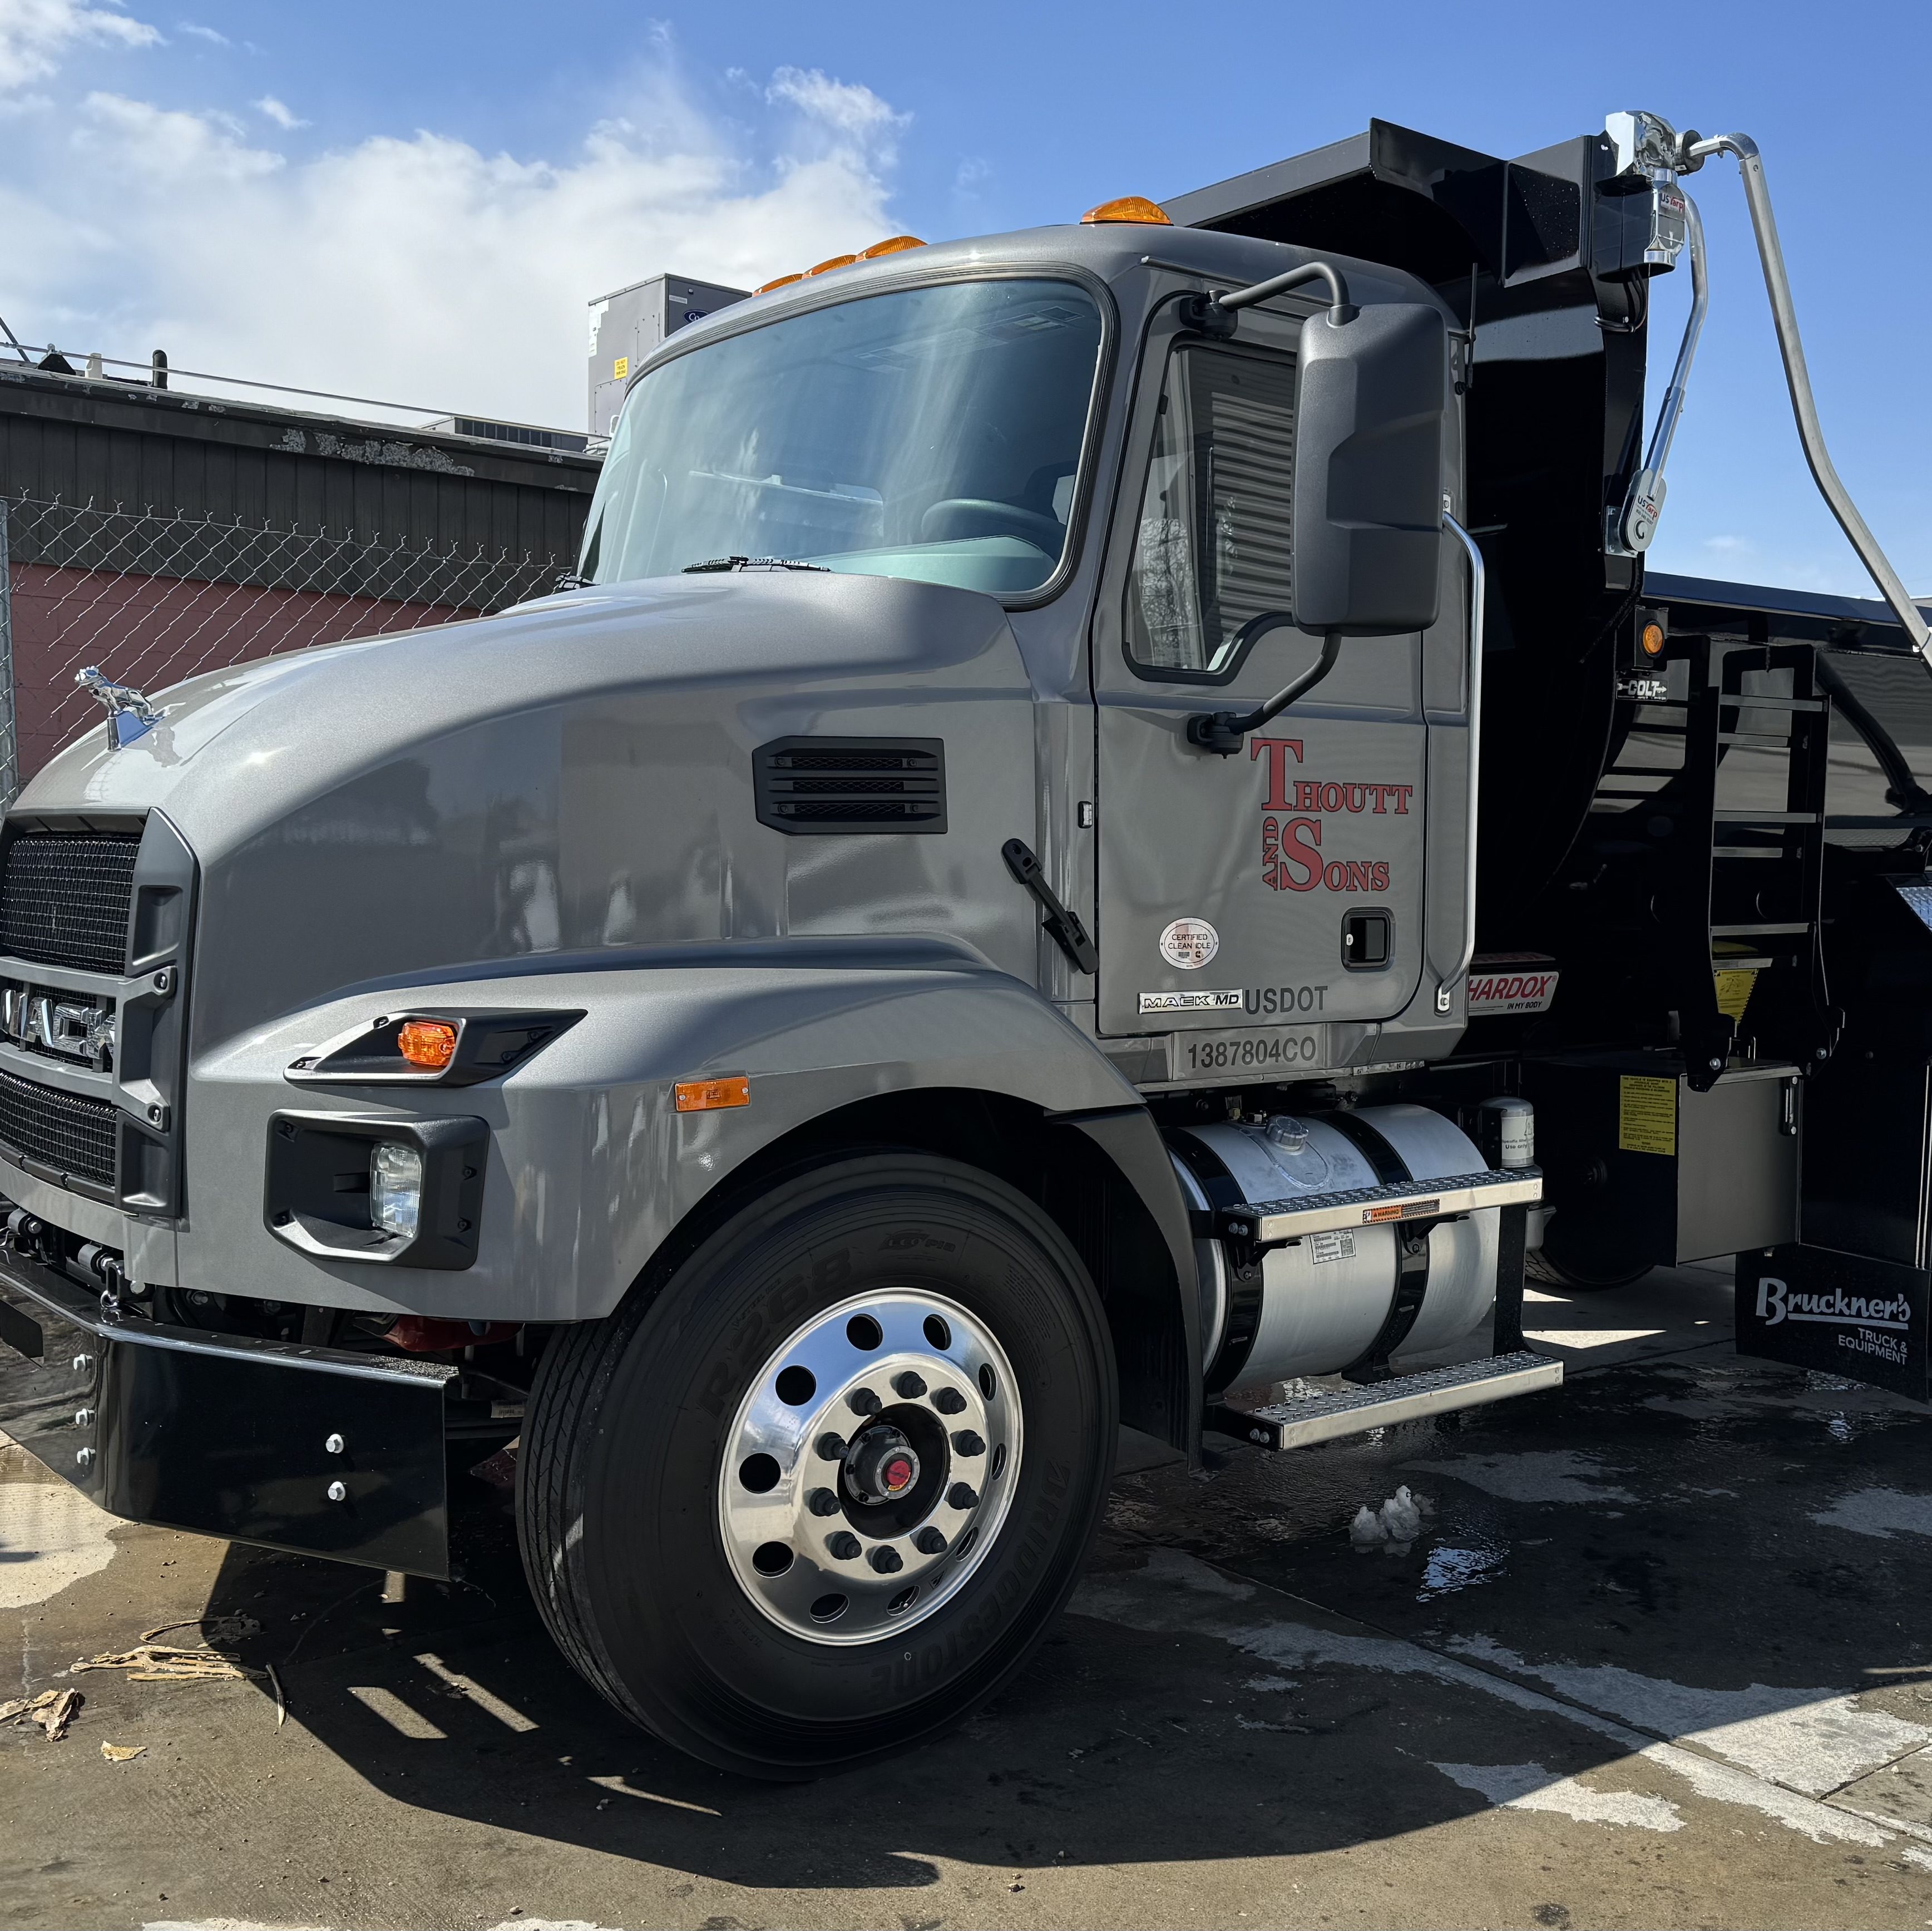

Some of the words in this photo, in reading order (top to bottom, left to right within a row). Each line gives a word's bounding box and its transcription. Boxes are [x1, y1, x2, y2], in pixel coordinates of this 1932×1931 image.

[1628, 680, 1660, 697] COLT
[1251, 737, 1413, 814] THOUTT
[1262, 816, 1278, 891] AND
[1280, 817, 1390, 891] SONS
[1144, 995, 1210, 1009] MACK
[1214, 994, 1239, 1005] MD
[1245, 986, 1328, 1015] USDOT
[1188, 1036, 1317, 1069] 1387804CO
[1756, 1277, 1911, 1325] Bruckner's
[697, 1247, 853, 1418] R268
[1857, 1327, 1898, 1350] TRUCK
[1900, 1341, 1908, 1354] &
[1838, 1334, 1908, 1365] EQUIPMENT
